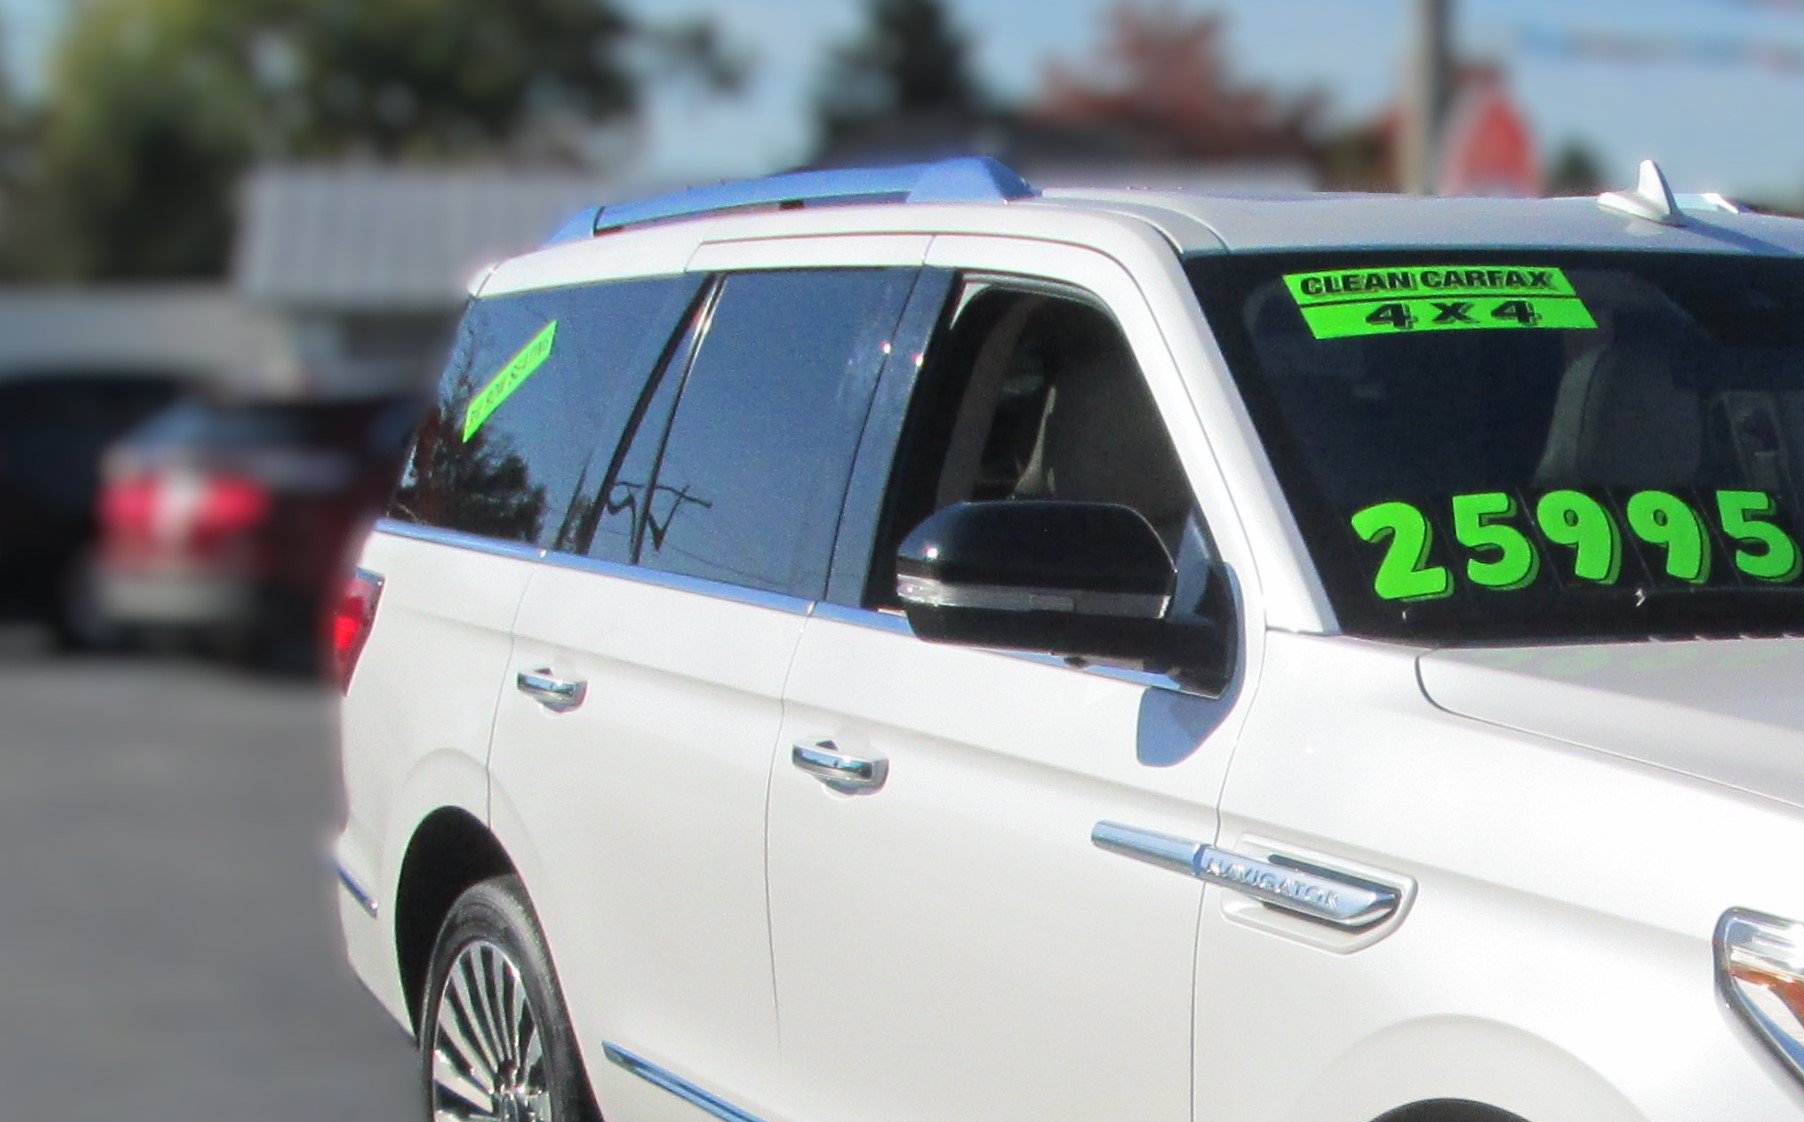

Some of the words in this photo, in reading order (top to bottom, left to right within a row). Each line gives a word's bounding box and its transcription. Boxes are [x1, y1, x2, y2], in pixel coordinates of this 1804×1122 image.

[1300, 271, 1418, 296] CLEAN
[1420, 269, 1555, 289] CARFAX
[1351, 490, 1802, 601] 25995
[1206, 857, 1340, 910] NAVIGATOR
